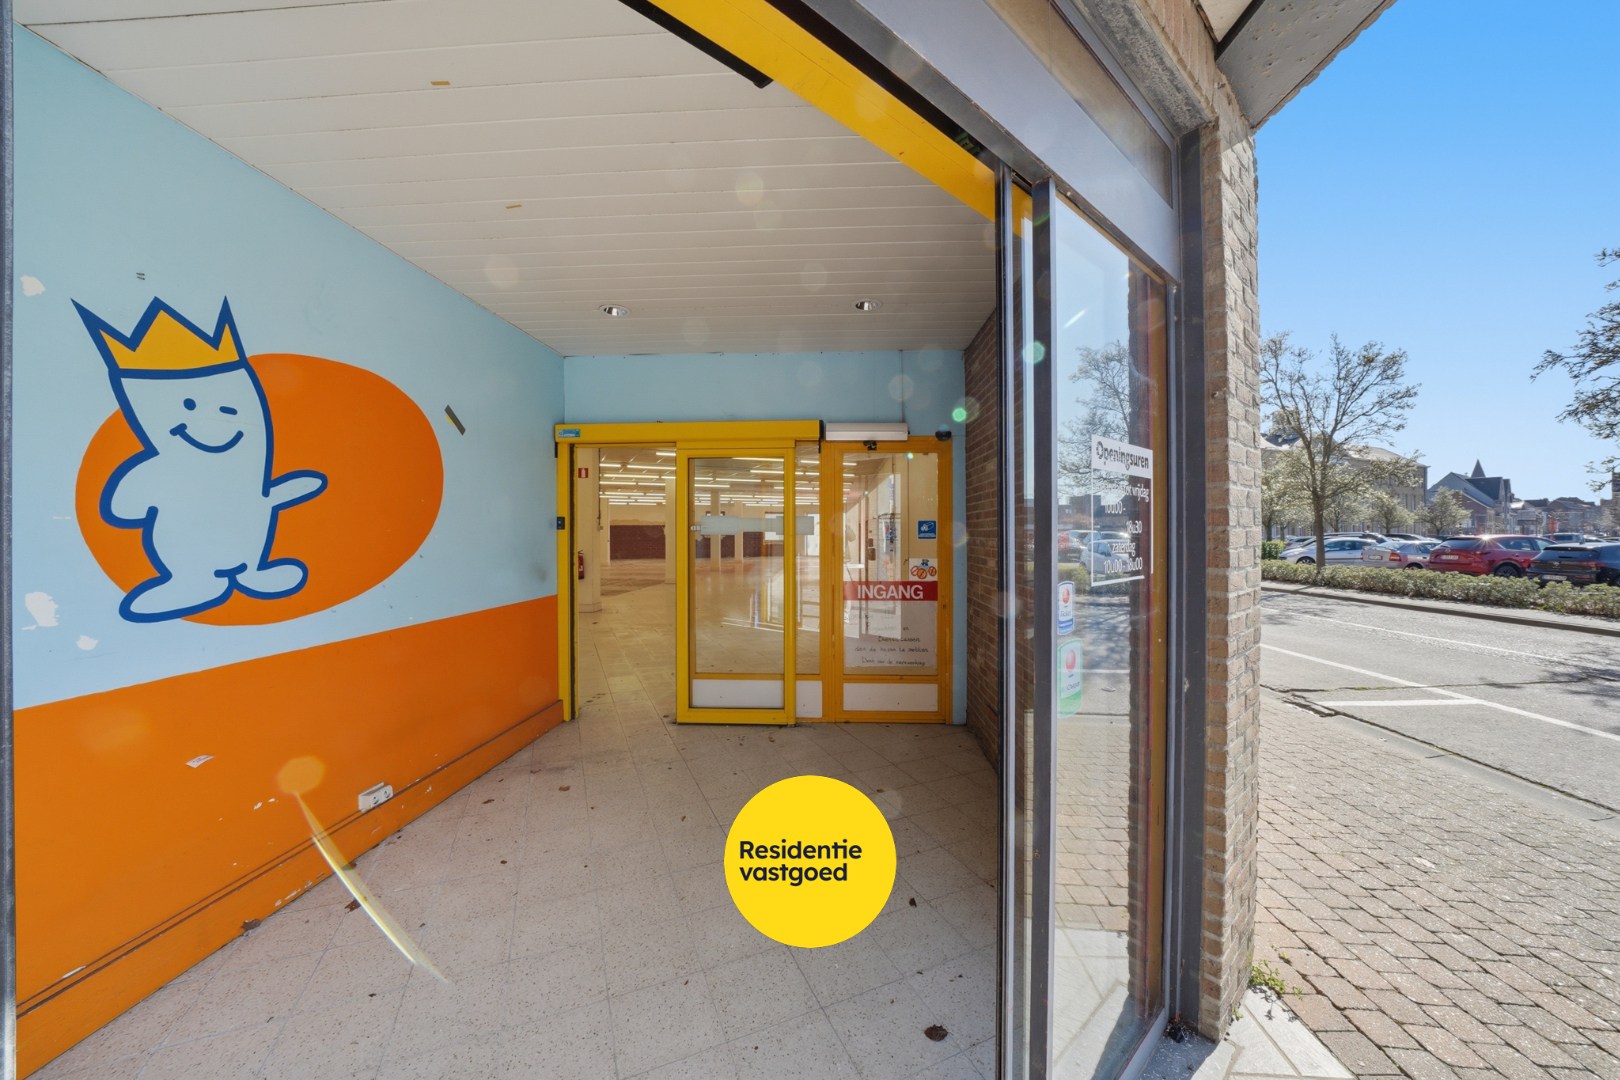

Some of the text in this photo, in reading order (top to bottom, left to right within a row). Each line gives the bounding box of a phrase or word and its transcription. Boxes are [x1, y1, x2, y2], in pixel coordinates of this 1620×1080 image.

[1096, 441, 1149, 470] Openingsuren
[1132, 483, 1149, 502] vrijdag
[1126, 520, 1143, 534] 18u30
[1111, 540, 1136, 557] zaterdag
[1104, 559, 1123, 574] 10u00
[1126, 557, 1143, 572] 18u00
[857, 584, 924, 599] INGANG
